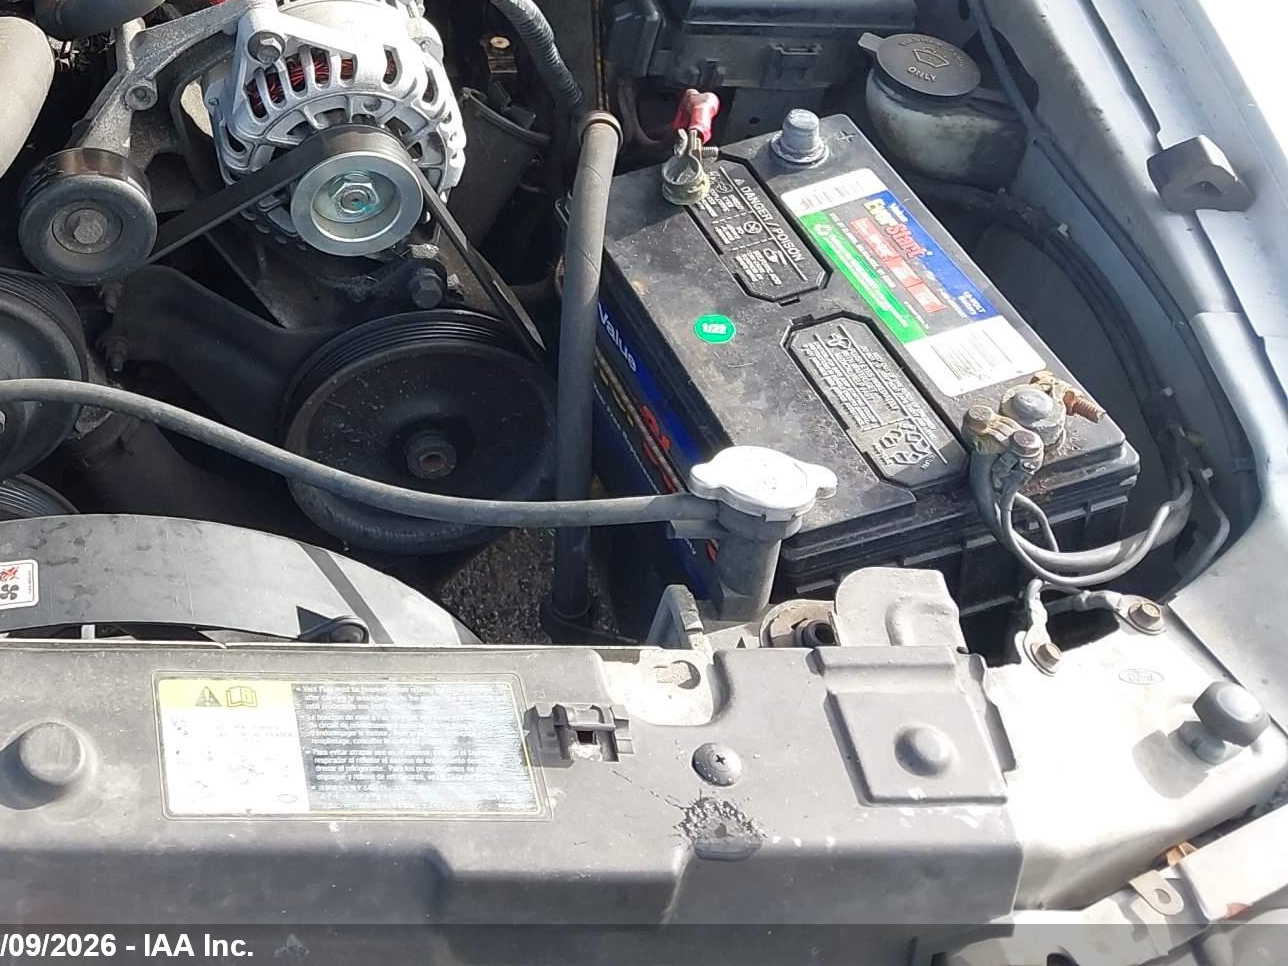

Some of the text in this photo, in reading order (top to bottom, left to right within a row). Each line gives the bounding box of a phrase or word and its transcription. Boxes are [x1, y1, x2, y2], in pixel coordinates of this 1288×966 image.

[907, 66, 937, 82] ONLY
[740, 186, 773, 221] DANGER
[772, 228, 804, 260] POISON
[864, 198, 926, 258] EverStart
[598, 302, 637, 373] Value
